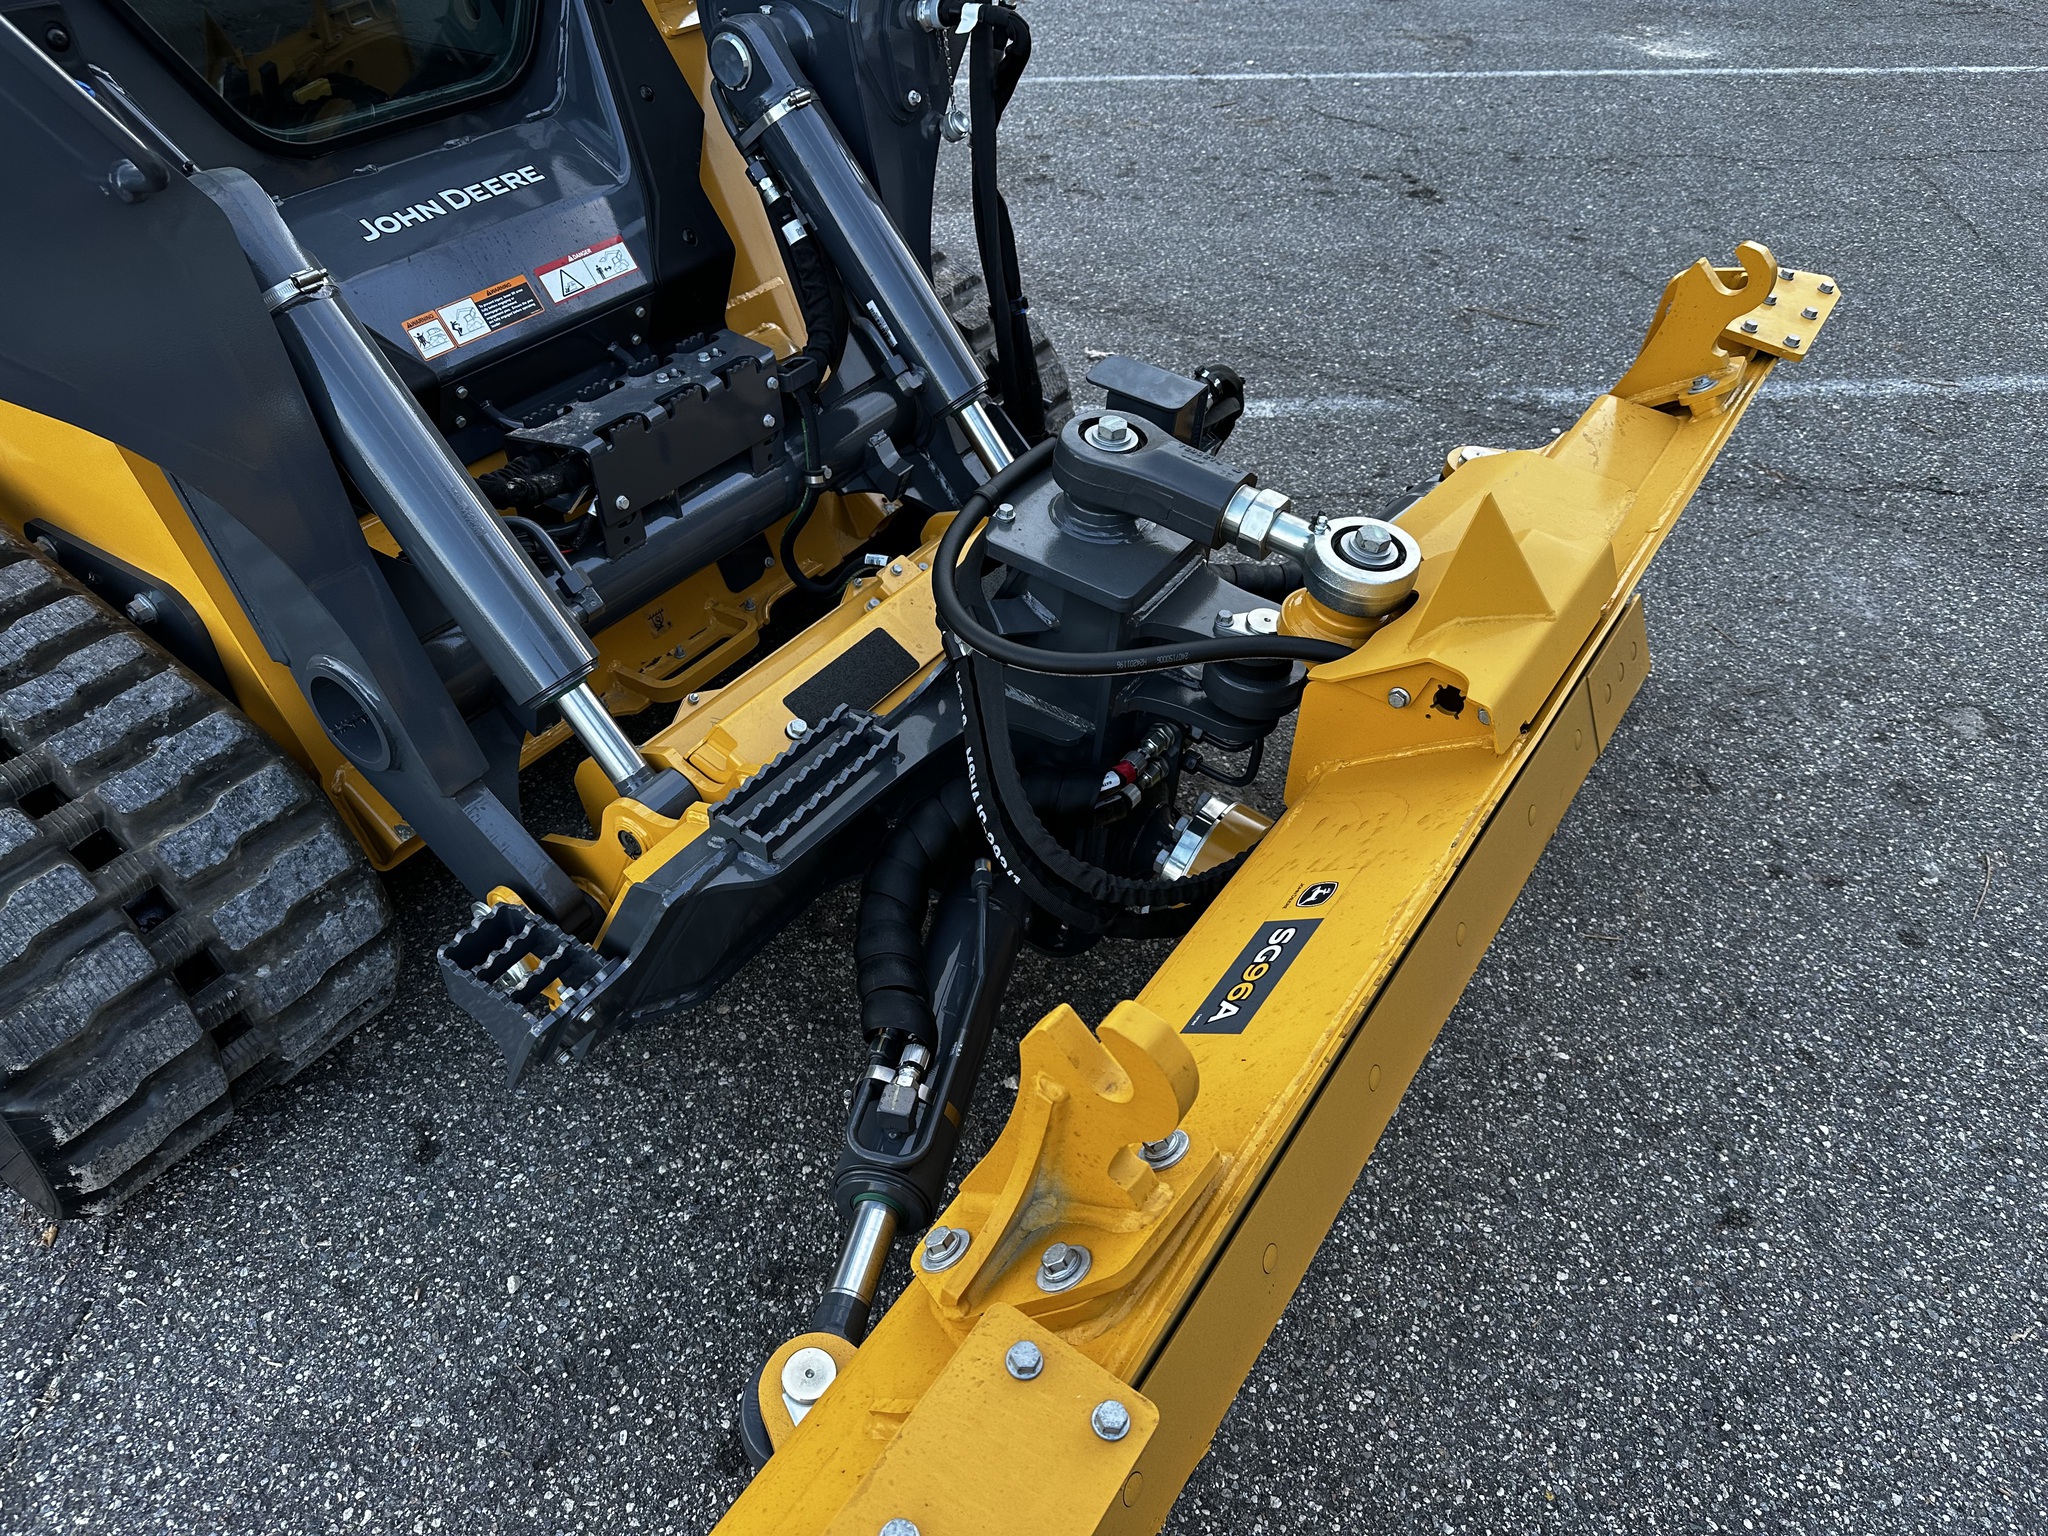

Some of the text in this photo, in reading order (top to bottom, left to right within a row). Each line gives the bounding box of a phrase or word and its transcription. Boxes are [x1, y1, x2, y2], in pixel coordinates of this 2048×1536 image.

[359, 164, 546, 242] JOHN DEERE
[571, 248, 592, 261] DANGER
[1206, 927, 1298, 1025] SG96A
